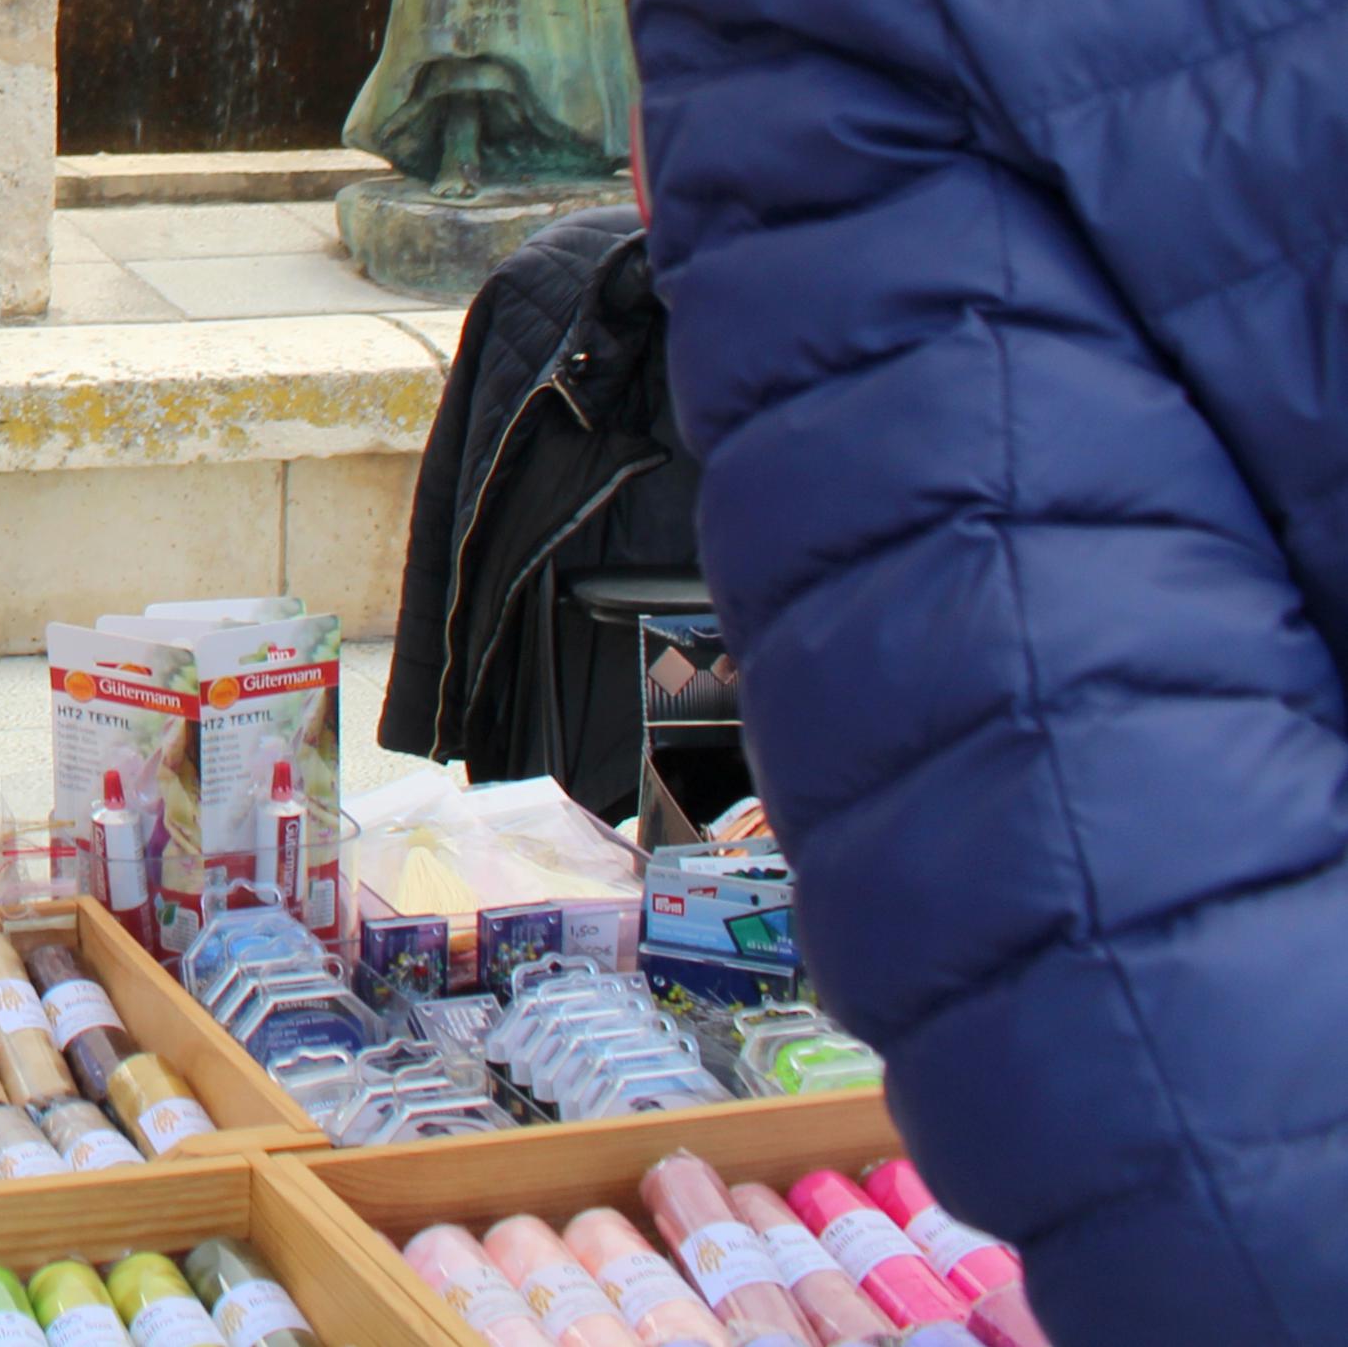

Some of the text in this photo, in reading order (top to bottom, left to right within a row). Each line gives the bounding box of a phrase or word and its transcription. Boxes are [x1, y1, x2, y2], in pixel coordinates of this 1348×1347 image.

[98, 676, 182, 709] Gütermann
[243, 667, 323, 692] Gütermann
[57, 704, 133, 731] HT2 TEXTIL
[230, 709, 274, 727] TEXTIL
